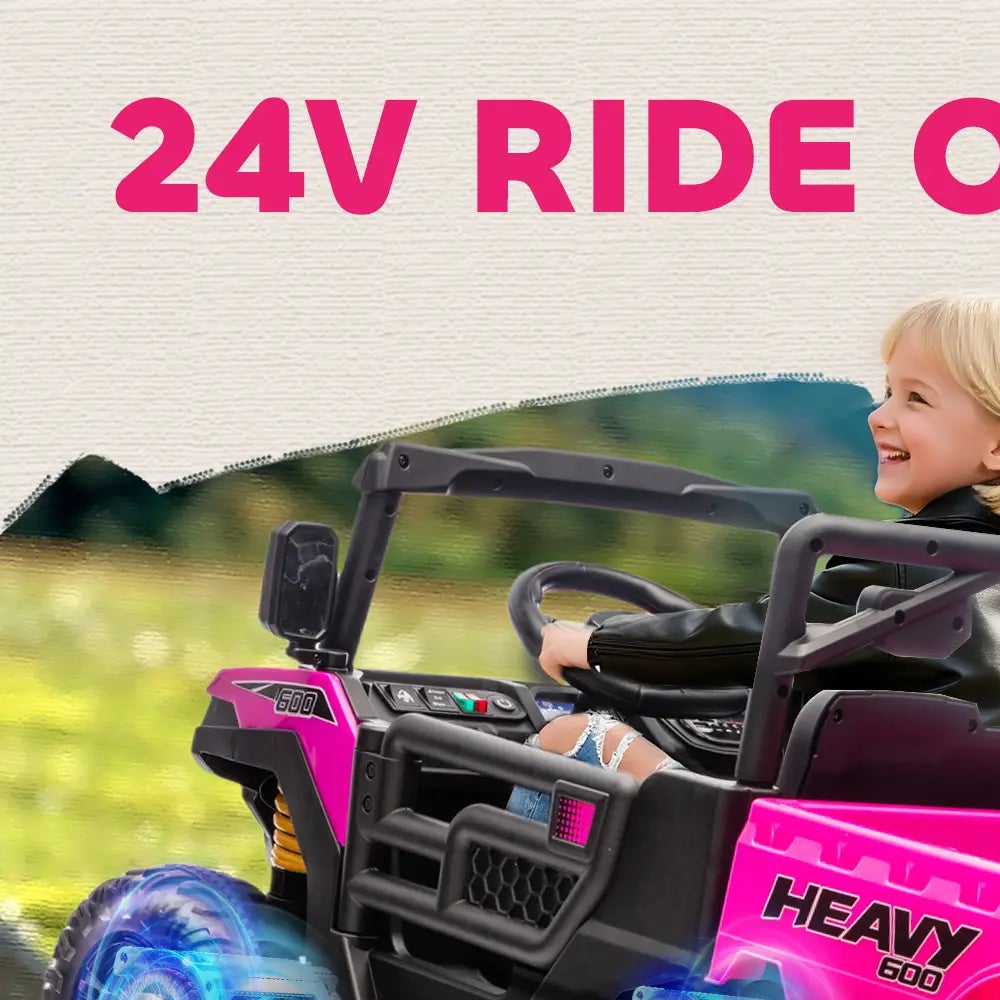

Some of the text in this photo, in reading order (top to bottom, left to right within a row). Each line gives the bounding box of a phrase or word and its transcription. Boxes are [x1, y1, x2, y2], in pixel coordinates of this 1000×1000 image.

[276, 689, 318, 717] 600
[762, 875, 982, 970] HEAVY
[878, 956, 943, 993] 600
